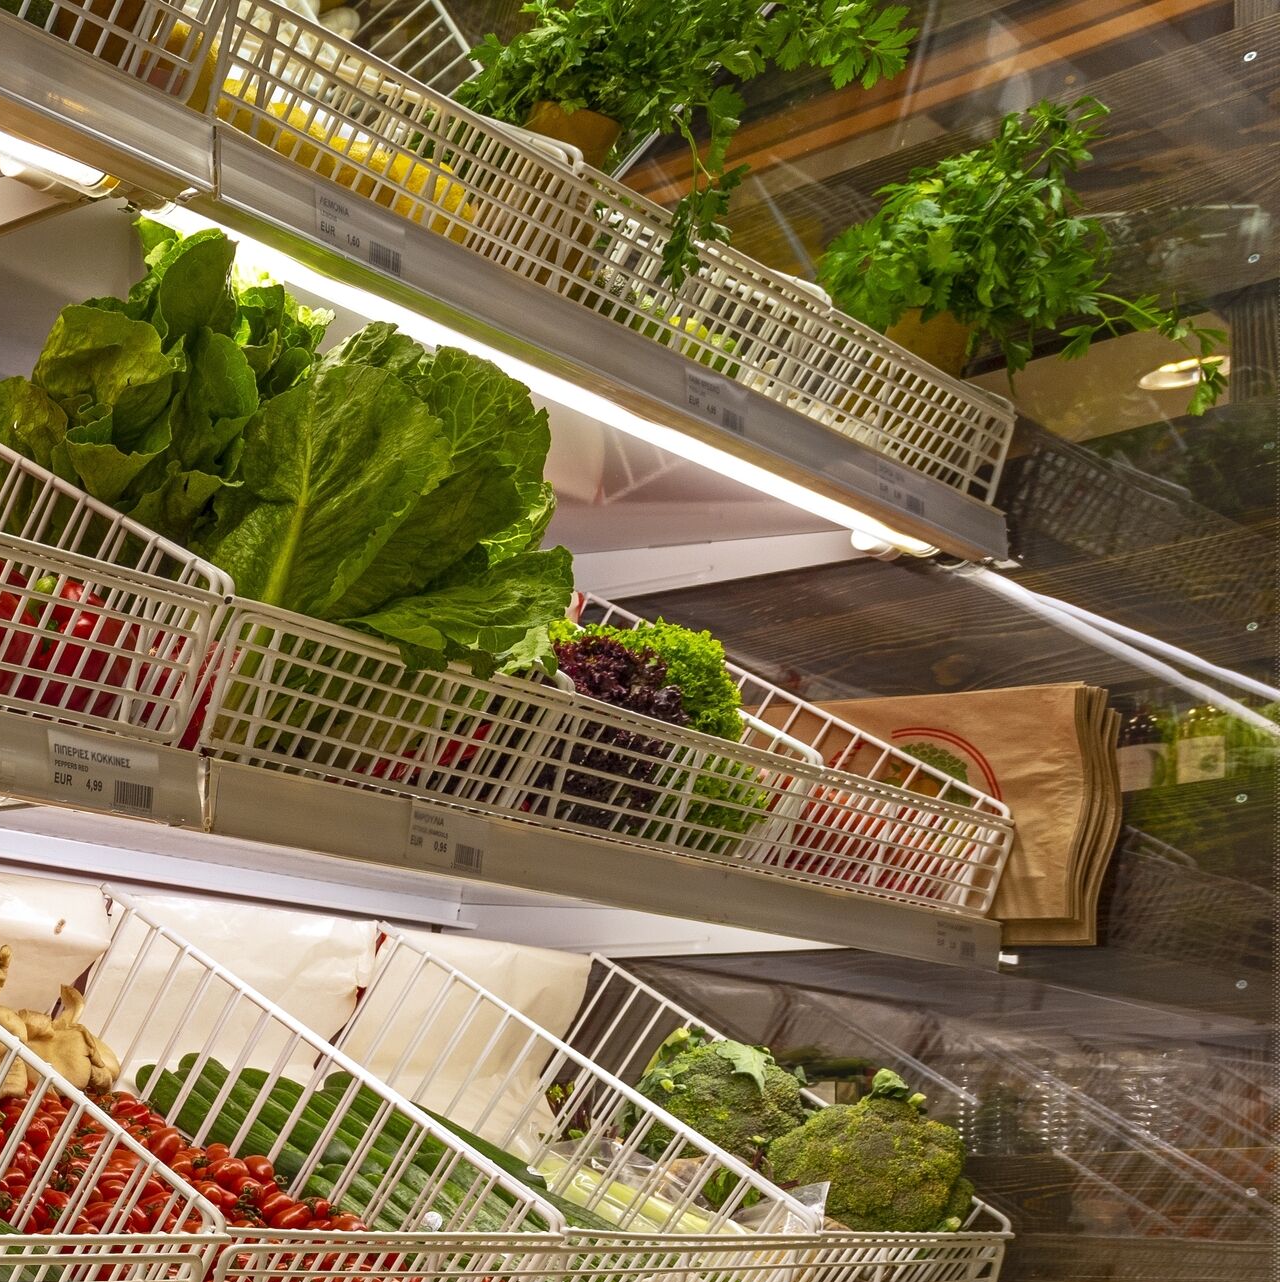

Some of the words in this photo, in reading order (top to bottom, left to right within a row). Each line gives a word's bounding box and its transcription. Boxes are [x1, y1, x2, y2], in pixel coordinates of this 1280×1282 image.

[321, 221, 336, 237] EUR
[54, 743, 89, 760] ΠΙΠΕΡΙΕΣ
[91, 752, 131, 769] ΚΟΚΚΙΝΕΣ
[54, 772, 73, 786] EUR
[86, 778, 103, 792] 4,99
[410, 834, 423, 848] EUR
[433, 841, 448, 853] 0,95
